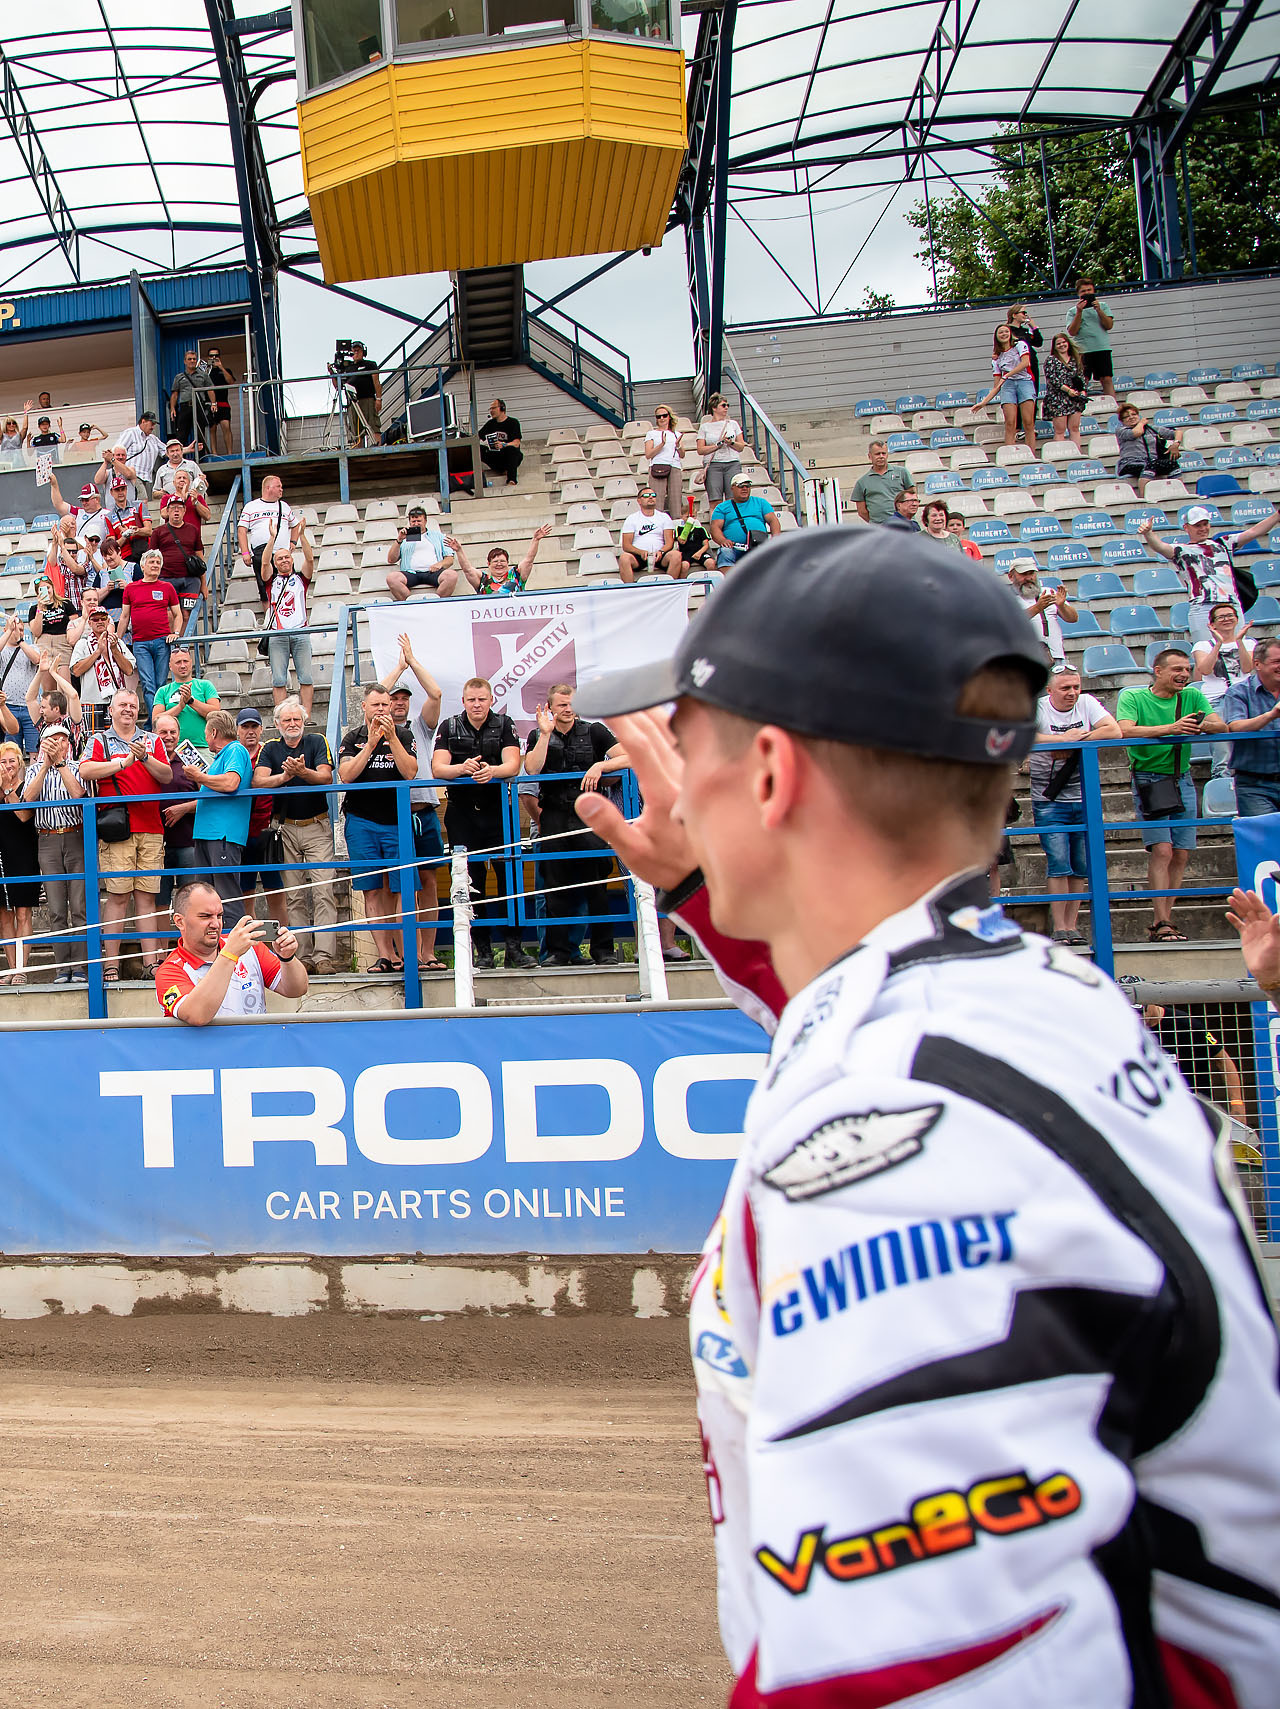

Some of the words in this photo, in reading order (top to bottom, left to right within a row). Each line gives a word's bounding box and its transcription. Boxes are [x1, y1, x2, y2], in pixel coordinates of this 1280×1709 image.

[471, 603, 575, 620] DAUGAVPILS
[266, 1190, 341, 1220] CAR
[354, 1188, 472, 1219] PARTS
[483, 1187, 626, 1219] ONLINE
